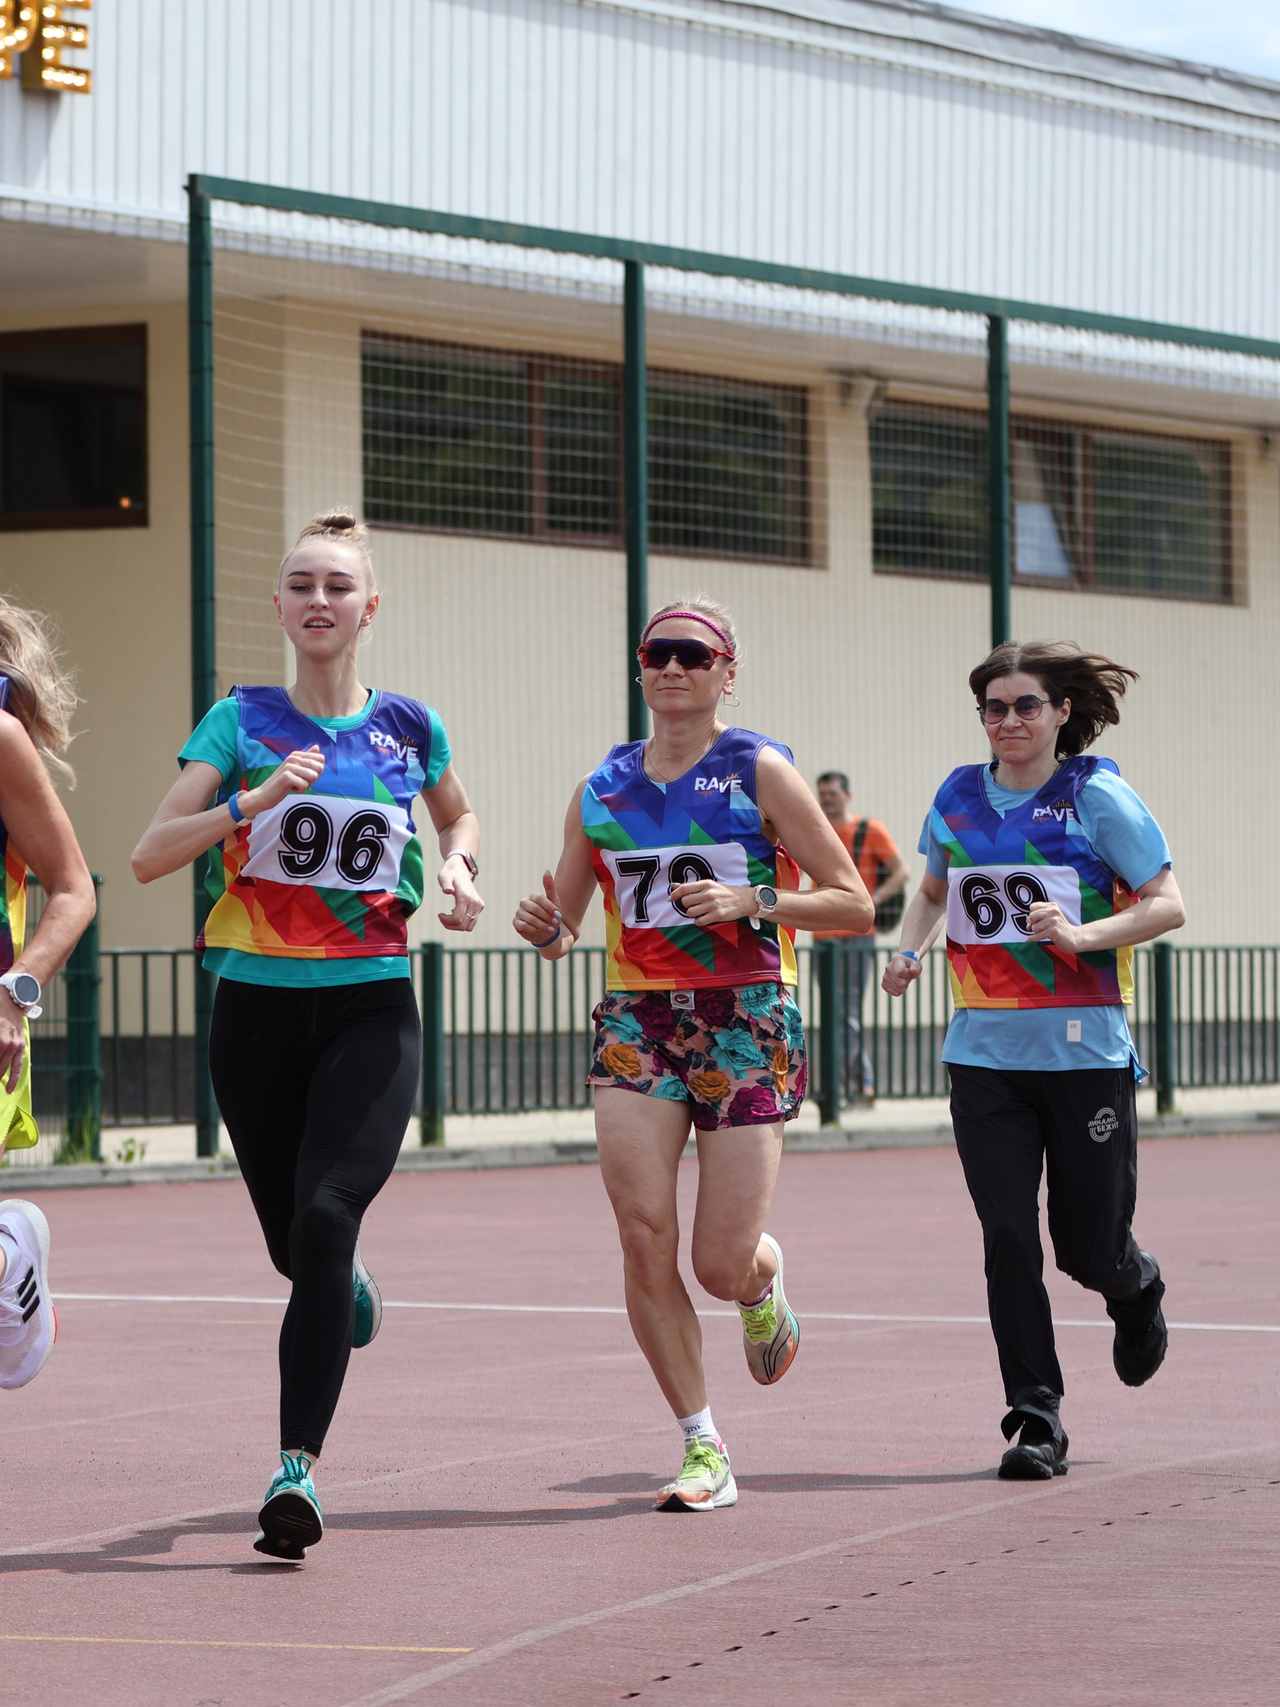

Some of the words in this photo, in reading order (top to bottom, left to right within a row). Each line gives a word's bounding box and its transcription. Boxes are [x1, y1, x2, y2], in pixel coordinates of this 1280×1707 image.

[370, 732, 419, 762] RAVE
[694, 777, 742, 793] RAVE
[278, 802, 391, 884] 96
[959, 872, 1050, 939] 69
[1087, 1116, 1117, 1128] ДИНАМО
[1096, 1121, 1119, 1133] БЕЖИТ
